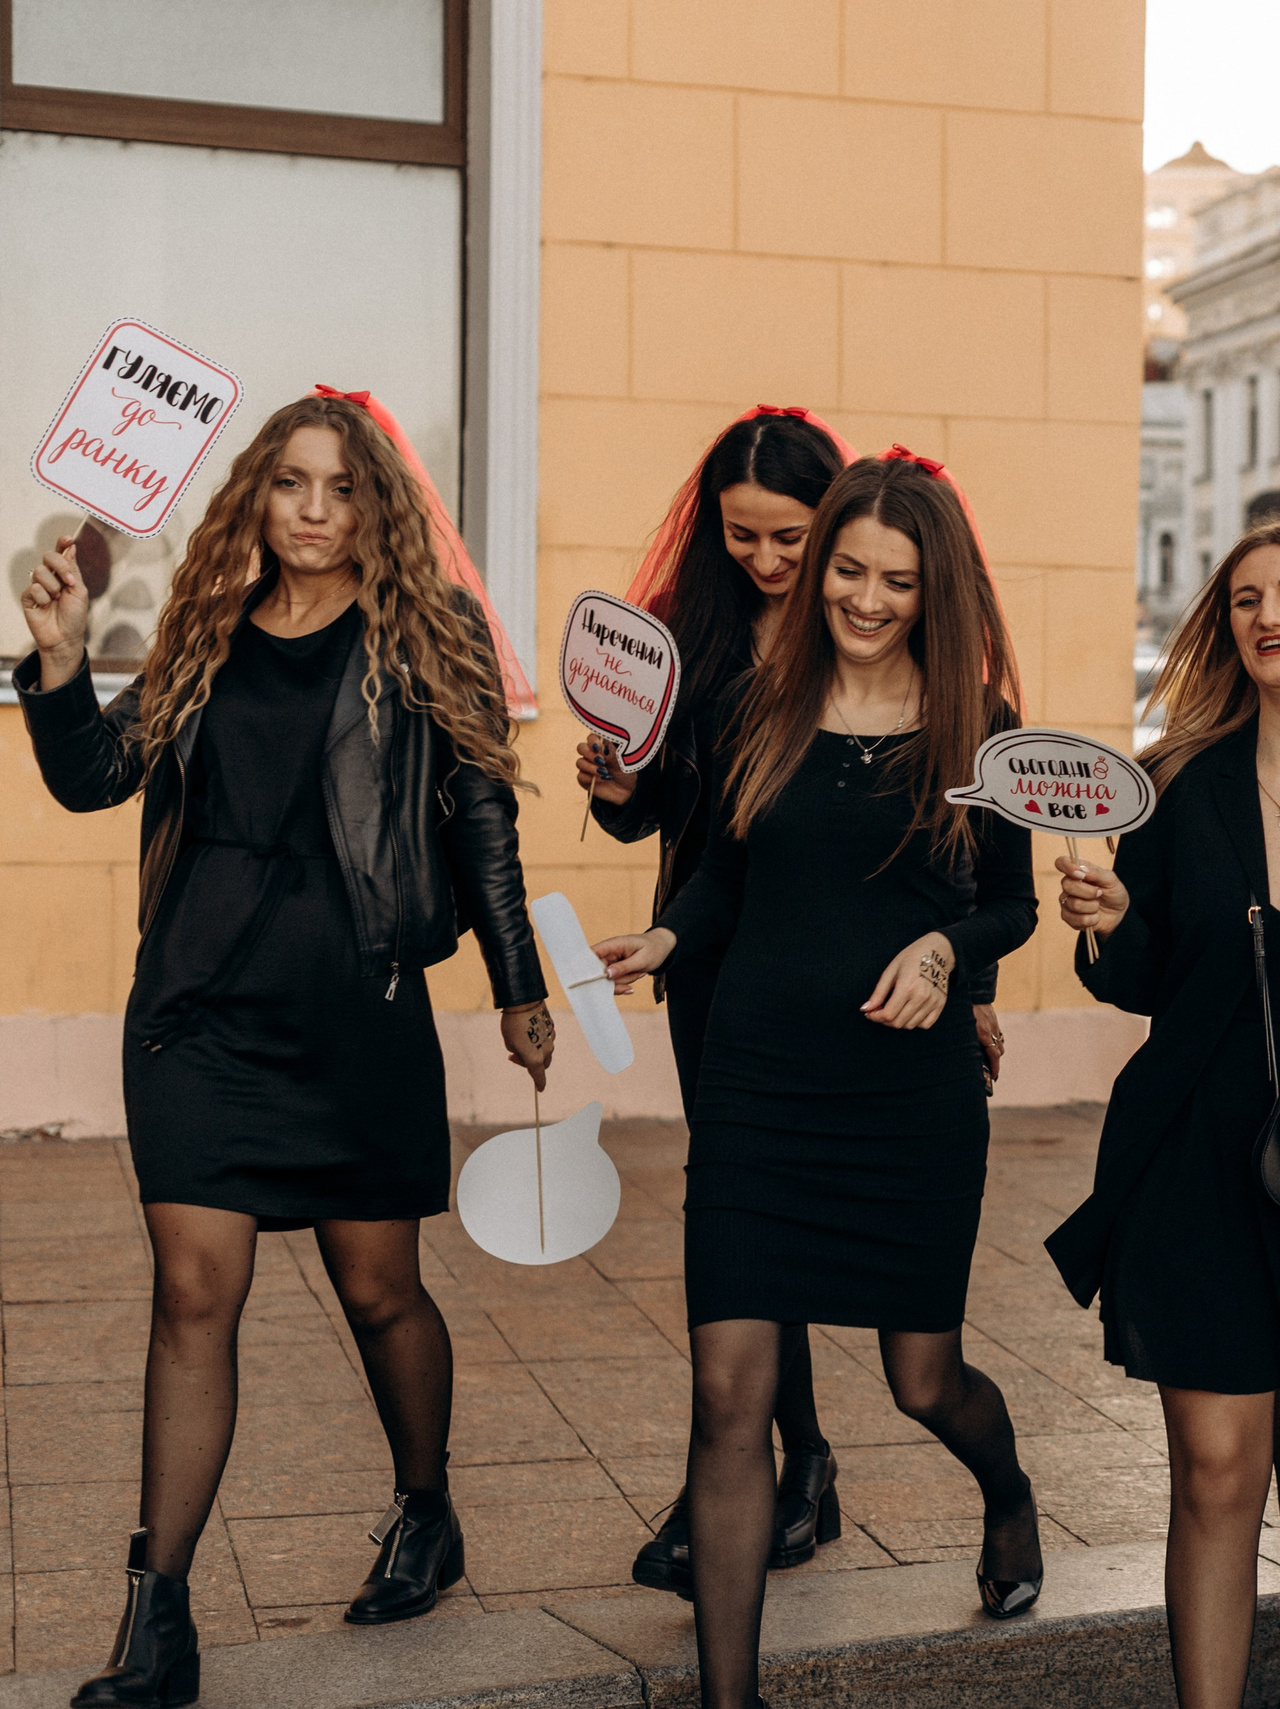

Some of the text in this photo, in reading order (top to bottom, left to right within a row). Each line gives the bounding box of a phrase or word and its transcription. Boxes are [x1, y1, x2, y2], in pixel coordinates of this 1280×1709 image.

[102, 346, 224, 424] ГУЛЯЄМО
[111, 387, 182, 436] до
[47, 428, 169, 511] ранку
[582, 607, 664, 670] Наречений
[596, 647, 632, 676] не
[568, 657, 657, 715] дізнається
[1010, 778, 1117, 800] можна
